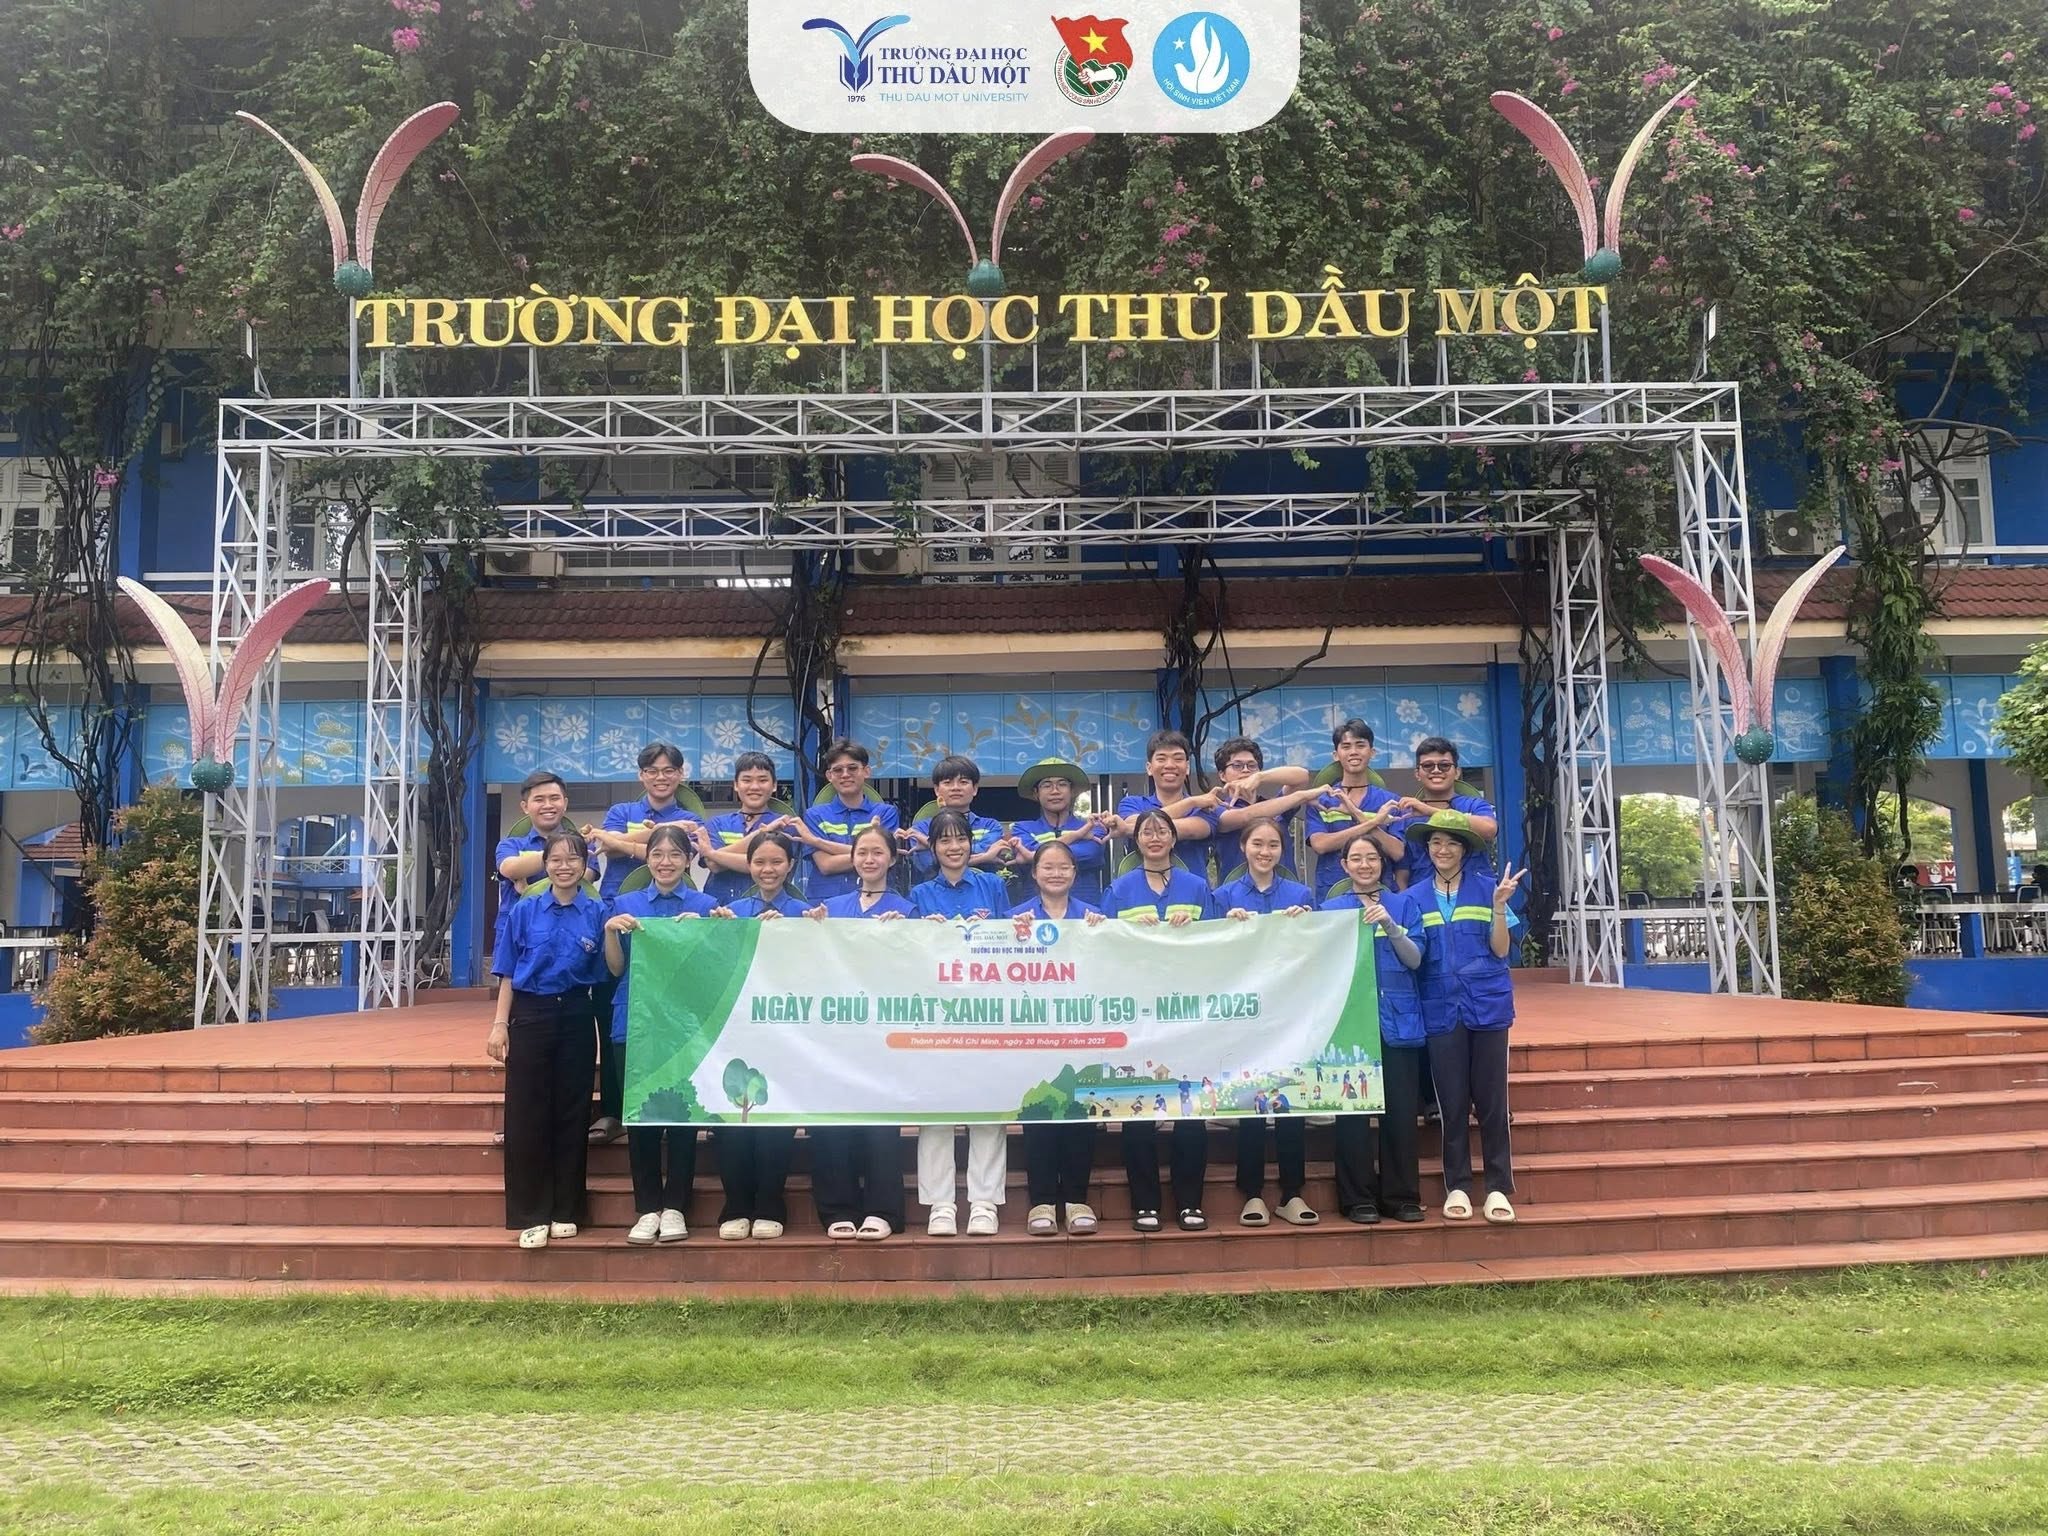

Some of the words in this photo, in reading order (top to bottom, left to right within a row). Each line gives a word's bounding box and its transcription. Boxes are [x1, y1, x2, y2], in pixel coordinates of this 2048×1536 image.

[355, 283, 695, 348] TRƯỜNG
[715, 296, 856, 360] ĐẠI
[873, 294, 1039, 361] HỌC
[1058, 276, 1227, 344] THỦ
[1246, 264, 1416, 340] DẦU
[1435, 272, 1608, 349] MỘT
[969, 962, 1002, 982] RA
[1006, 960, 1075, 983] QUÂN
[751, 992, 813, 1022] NGÀY
[820, 991, 869, 1022] CHỦ
[877, 993, 937, 1027] NHẬT
[940, 997, 1004, 1022] XANH
[1010, 990, 1047, 1023] LẦN
[1053, 993, 1097, 1023] THỨ
[1100, 996, 1136, 1022] 159
[1156, 991, 1201, 1020] NĂM
[1206, 992, 1260, 1018] 2025
[1003, 1038, 1023, 1047] ngày
[1037, 1037, 1060, 1047] tháng
[1068, 1037, 1086, 1046] năm
[1087, 1037, 1107, 1045] 2025
